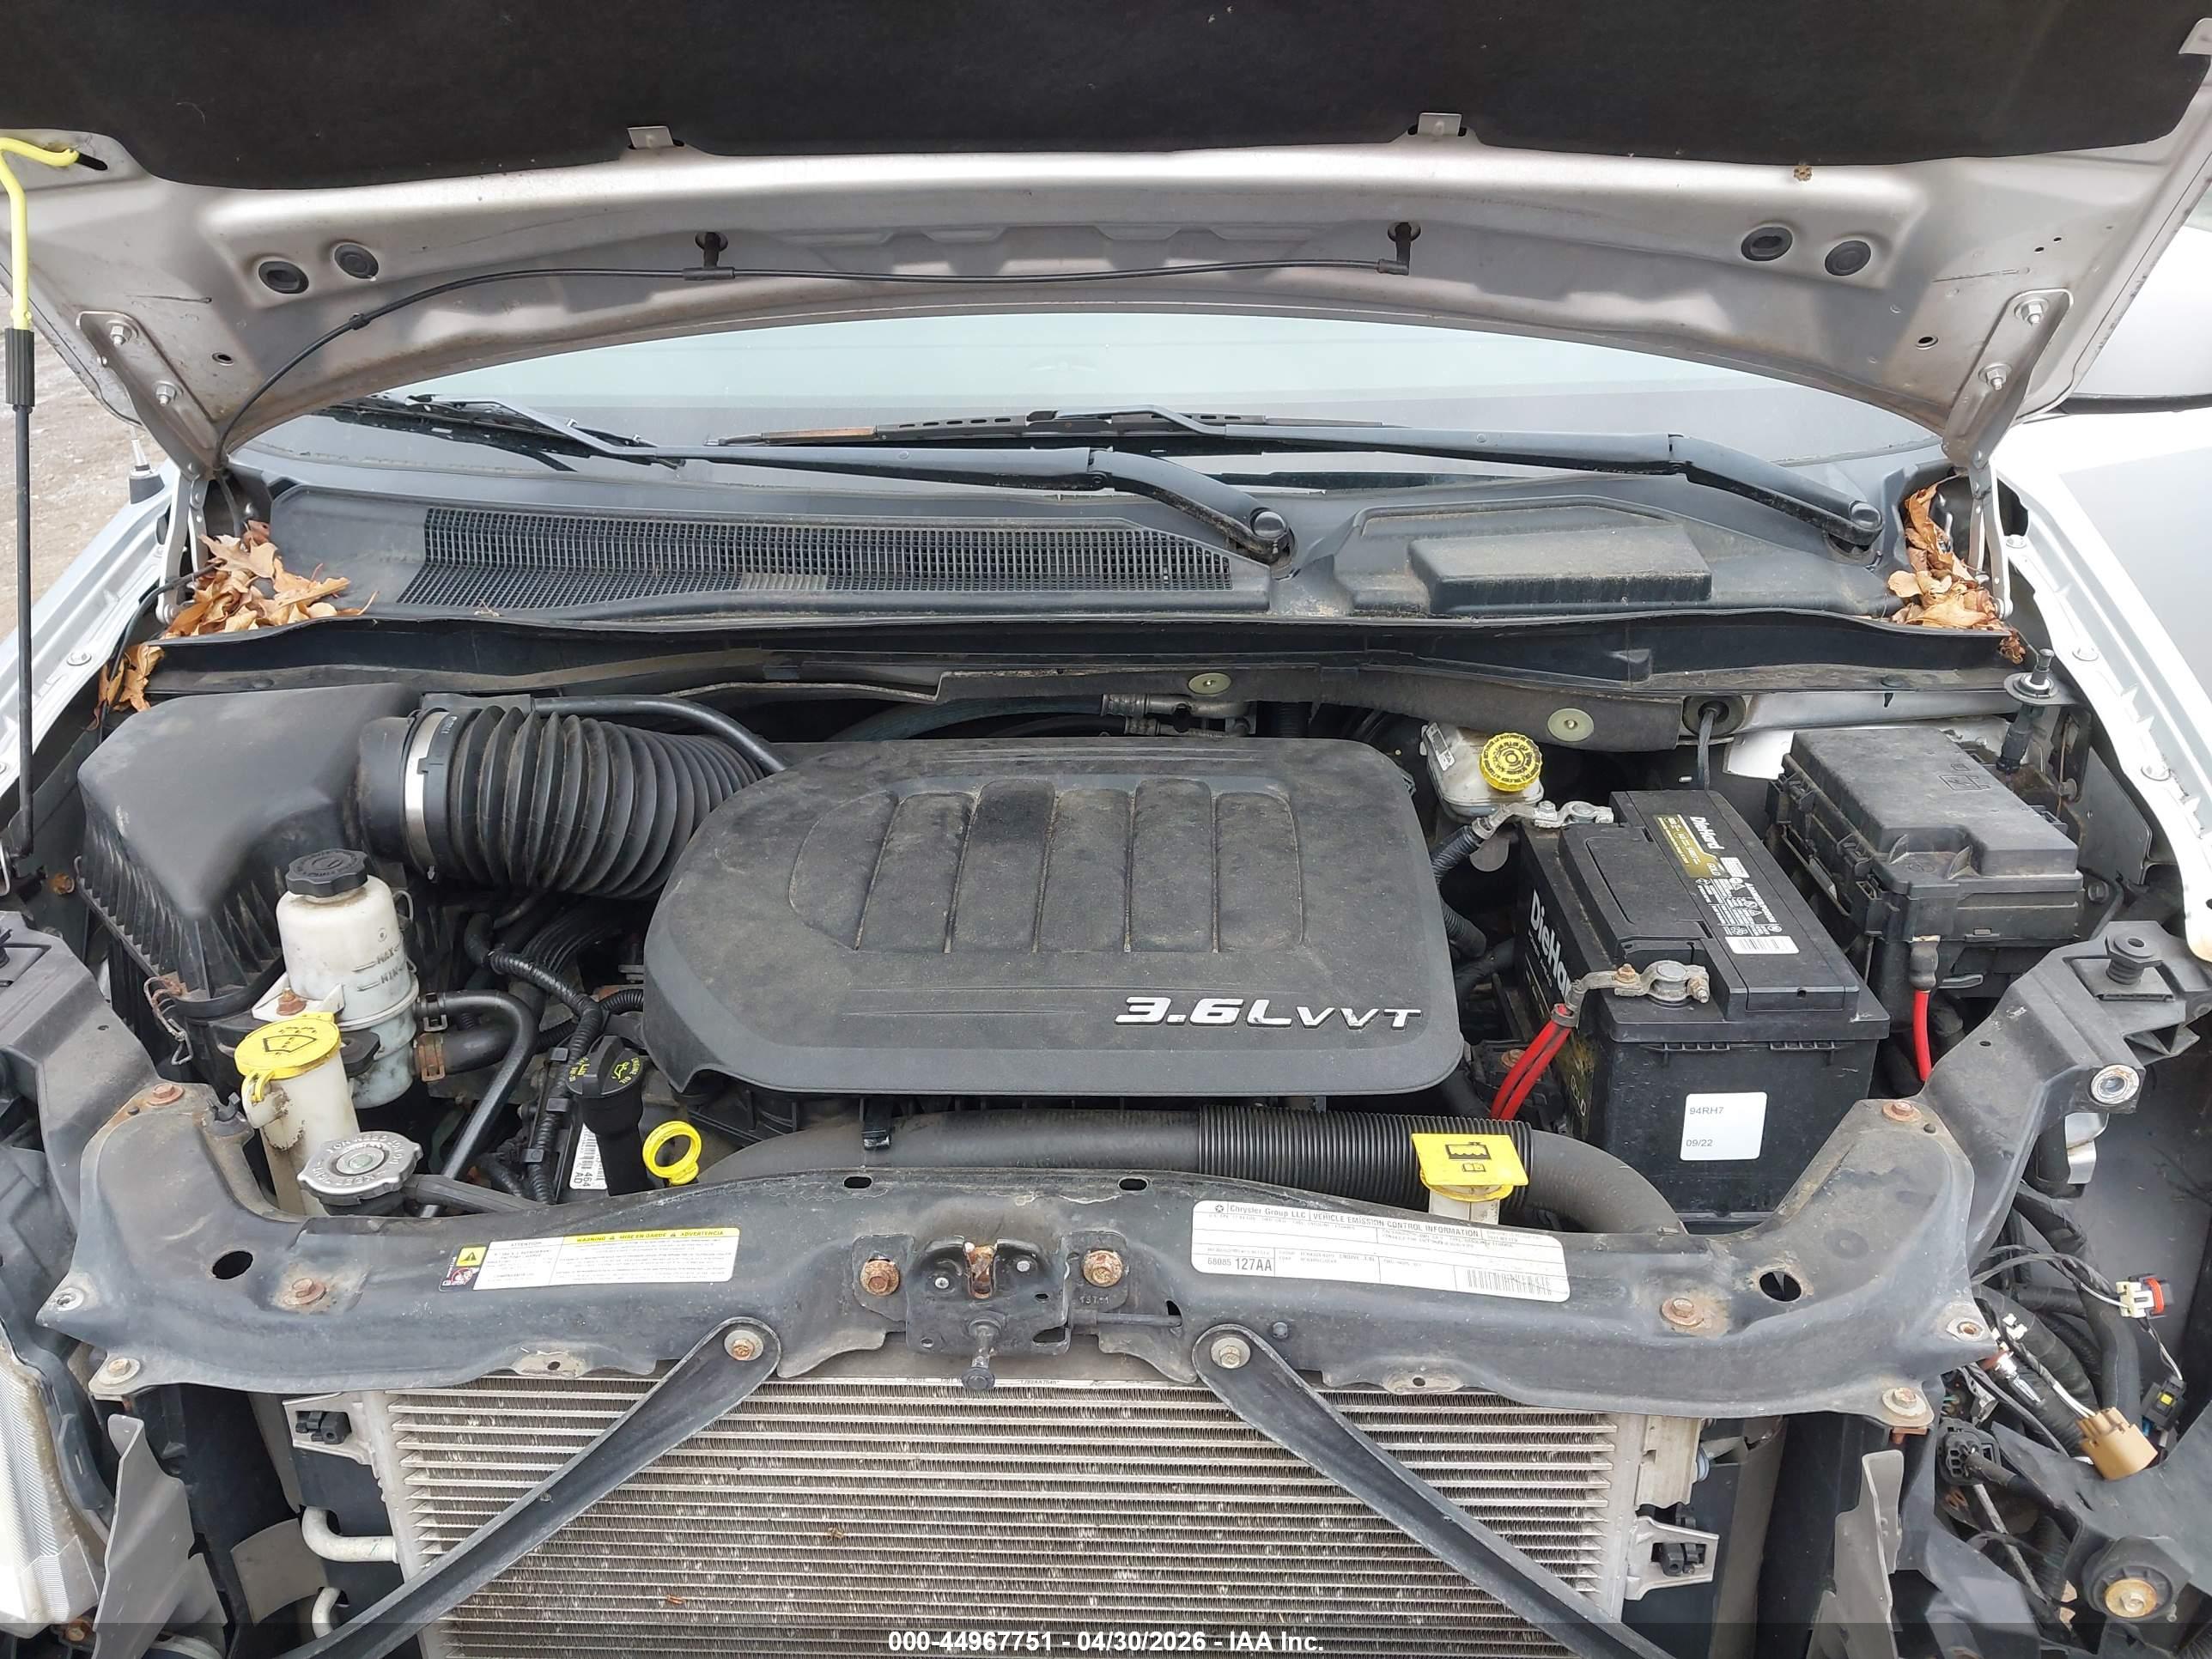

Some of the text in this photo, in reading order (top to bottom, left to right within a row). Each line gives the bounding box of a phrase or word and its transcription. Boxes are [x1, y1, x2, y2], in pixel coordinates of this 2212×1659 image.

[1689, 816, 1725, 850] DieHard
[1530, 888, 1572, 1003] DieHar
[1115, 996, 1422, 1030] 3.6L VVT
[619, 1076, 632, 1085] OIL
[1571, 1074, 1587, 1116] GOLD
[1689, 1106, 1724, 1115] 94RH7
[1686, 1139, 1714, 1147] 09/22
[583, 1171, 593, 1188] 464
[1230, 1204, 1262, 1214] Chrysler
[1265, 1207, 1289, 1218] Group
[1313, 1212, 1345, 1223] VEHICLE
[1347, 1216, 1385, 1227] EMISSION
[1387, 1221, 1424, 1231] CONTROL
[1425, 1224, 1479, 1237] INFORMATION
[1207, 1257, 1273, 1272] 68085 127AA
